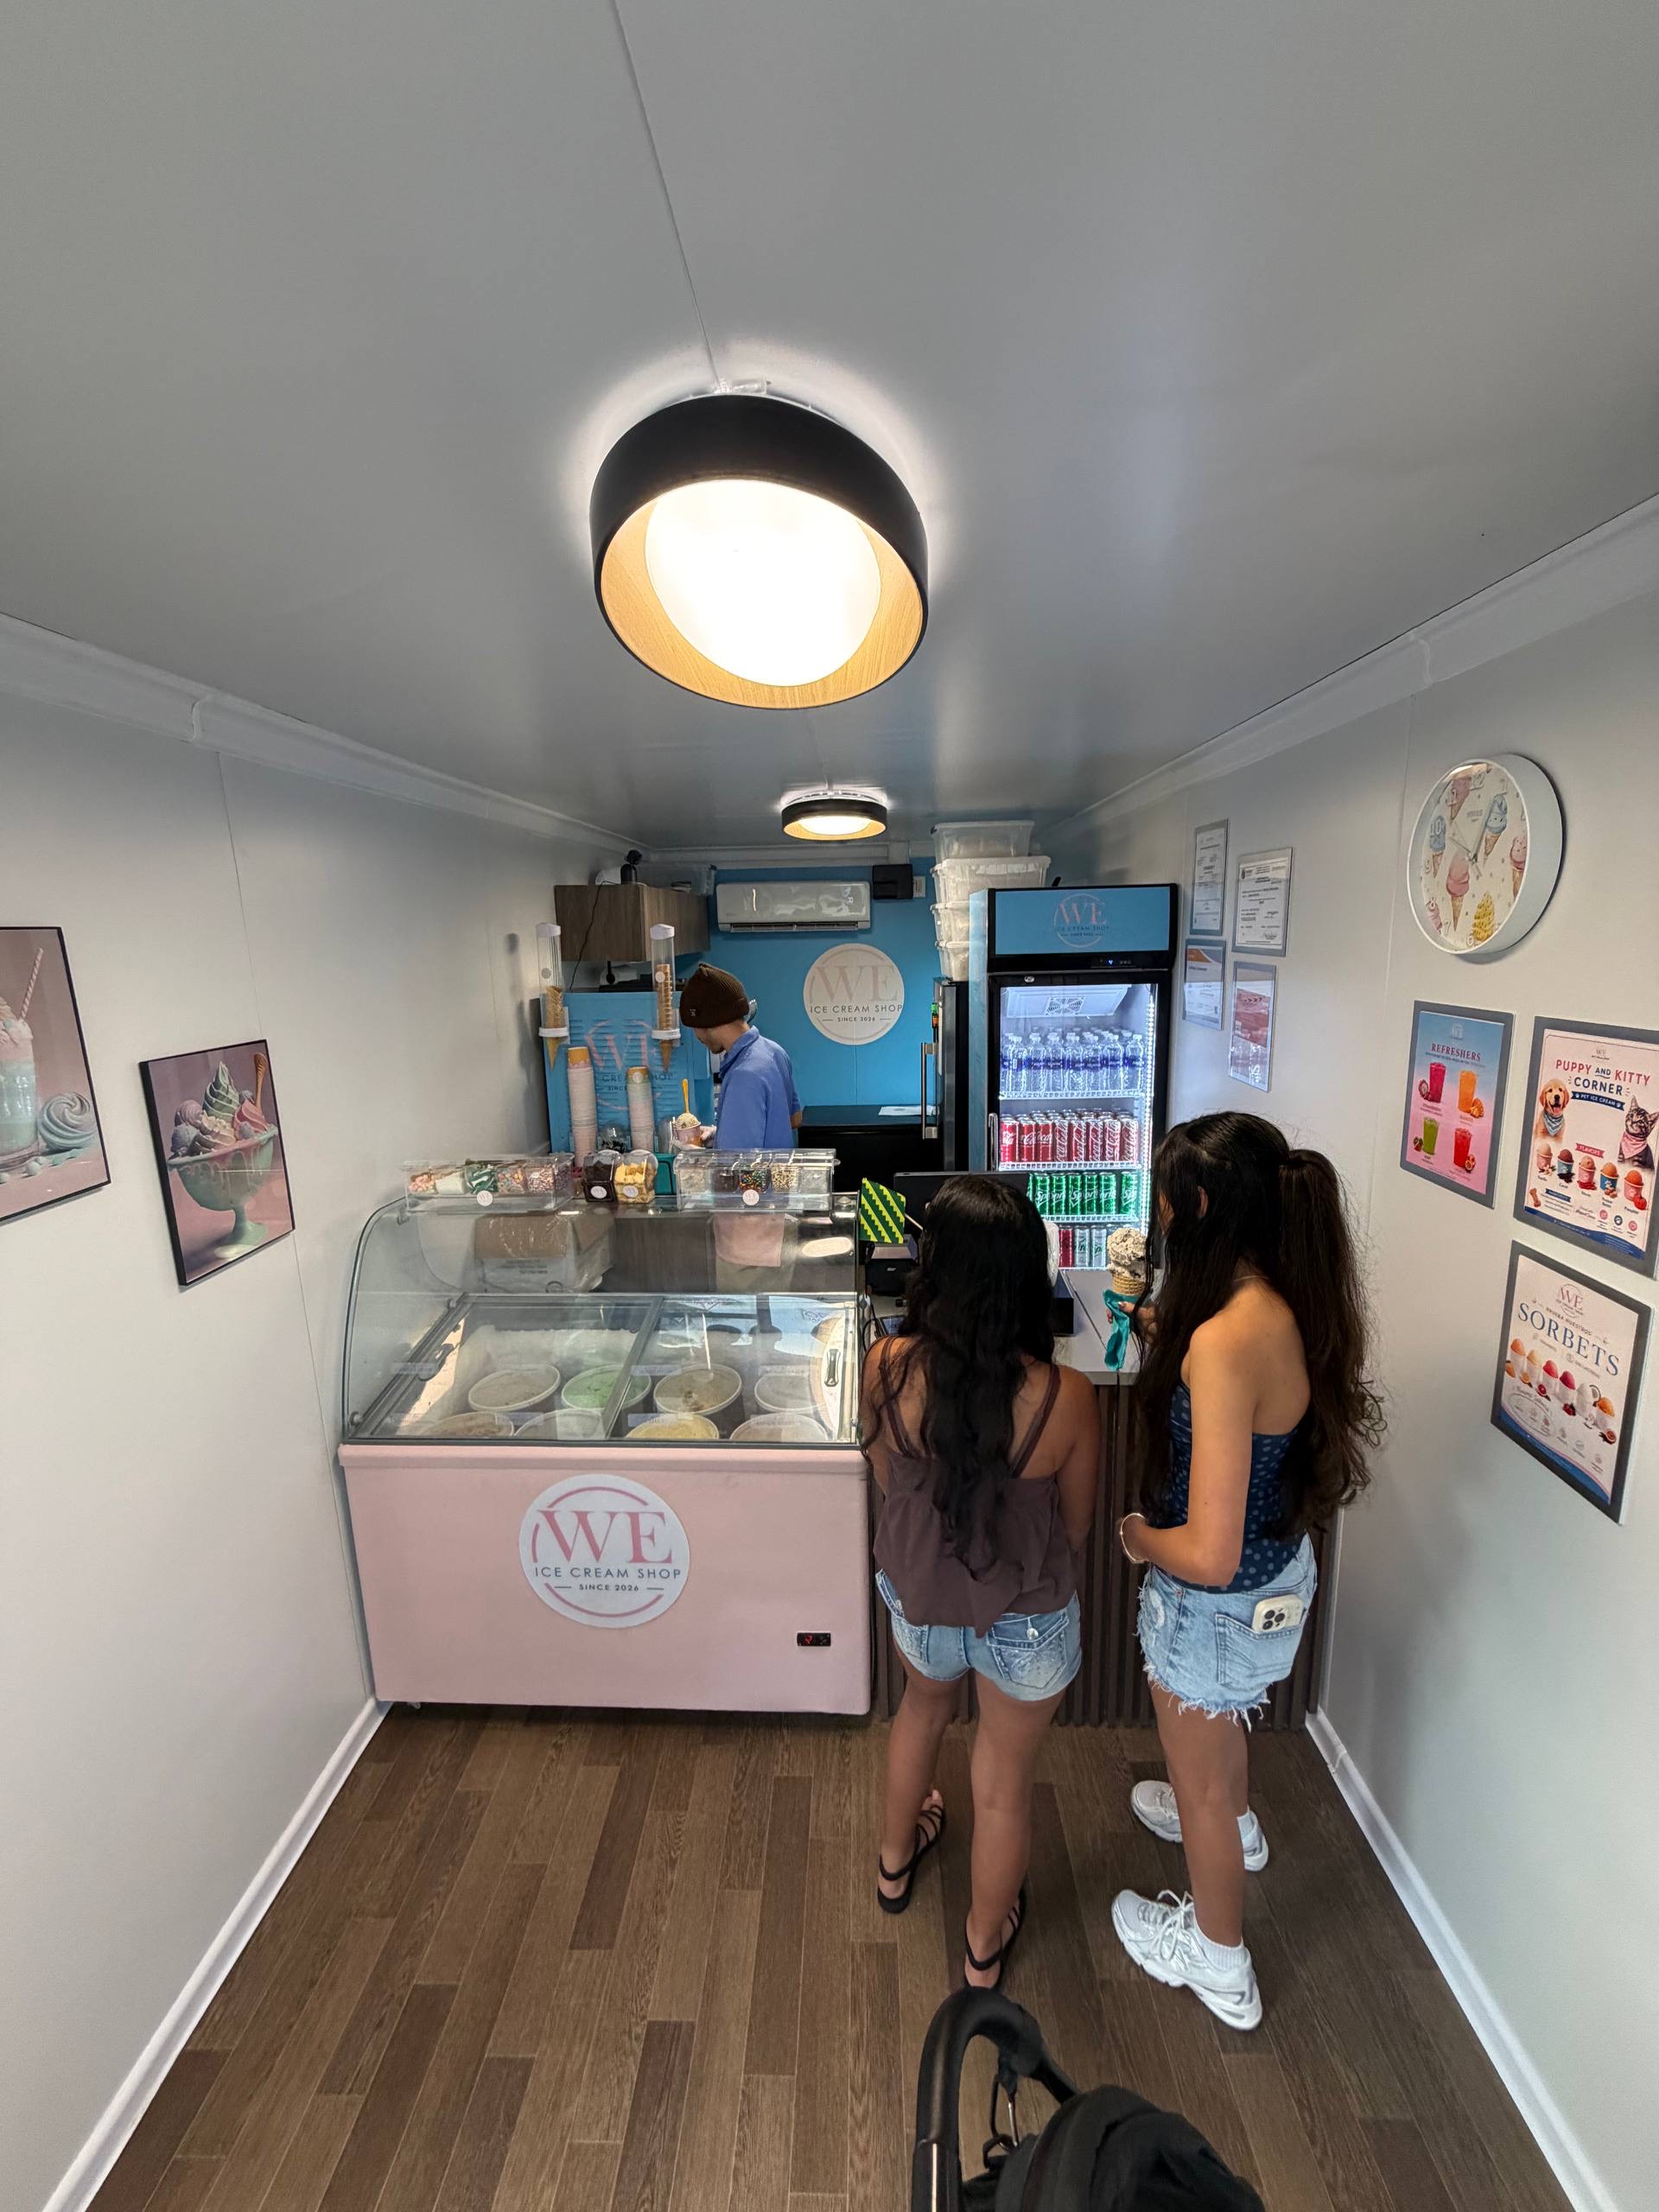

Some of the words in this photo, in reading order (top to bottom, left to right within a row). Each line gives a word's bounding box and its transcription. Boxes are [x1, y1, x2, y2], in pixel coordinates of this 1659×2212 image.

[1059, 902, 1107, 925] WE
[815, 965, 899, 1002] WE
[810, 1006, 829, 1014] ICE
[832, 1005, 871, 1014] CREAM
[874, 1004, 903, 1013] SHOP
[1431, 1043, 1481, 1062] REFRESHERS
[1555, 1059, 1592, 1075] PUPPY
[1595, 1067, 1611, 1076] AND
[1615, 1070, 1651, 1086] KITTY
[1574, 1077, 1623, 1096] CORNER
[1599, 1097, 1616, 1106] CREAM
[1518, 1303, 1619, 1376] SORBETS
[537, 1510, 672, 1564] WE
[535, 1567, 562, 1578] ICE
[569, 1567, 630, 1579] CREAM
[638, 1568, 681, 1580] SHOP
